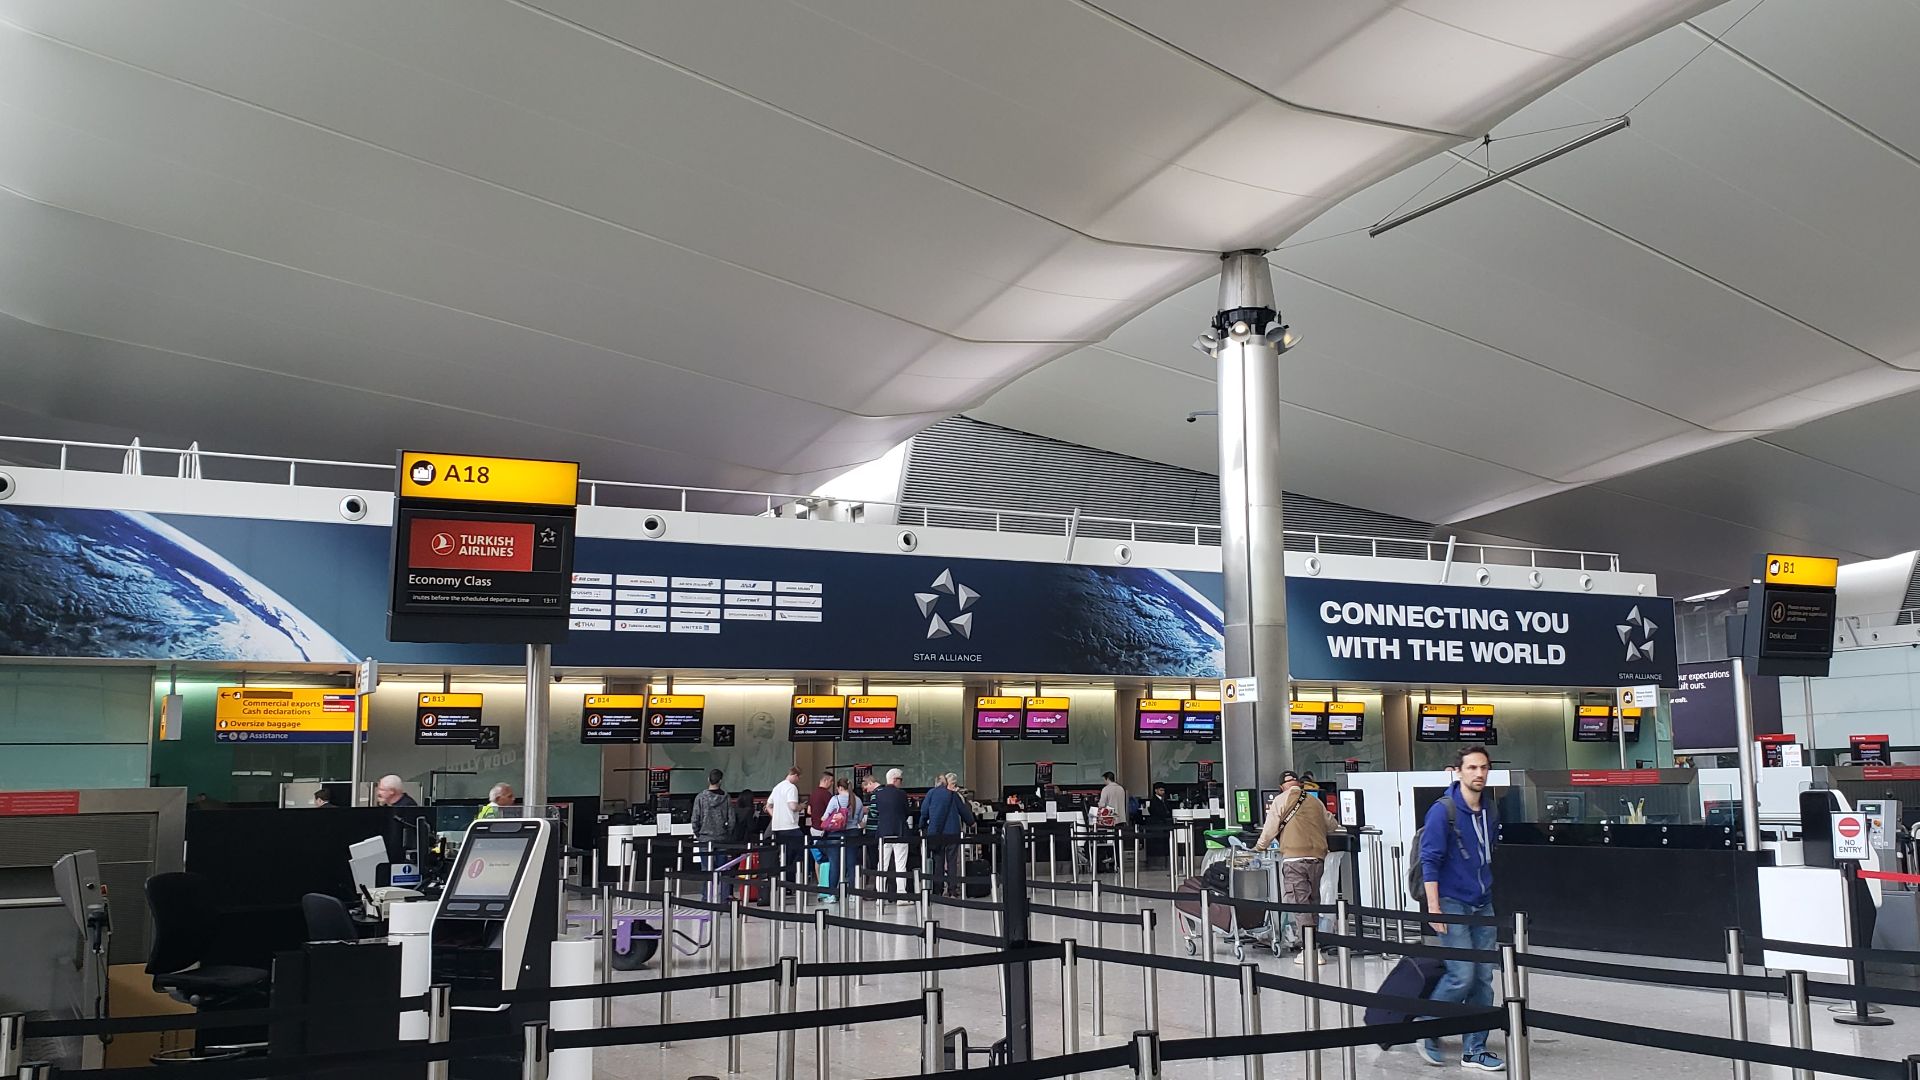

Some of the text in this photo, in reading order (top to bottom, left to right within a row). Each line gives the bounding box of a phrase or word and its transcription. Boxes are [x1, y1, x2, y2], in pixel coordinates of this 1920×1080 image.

[443, 464, 490, 484] A18
[460, 534, 514, 547] TURKISH
[458, 545, 514, 557] AIRLINES
[1783, 562, 1795, 574] B1
[408, 574, 492, 588] Economy Class
[1319, 600, 1569, 634] CONNECTING YOU
[1326, 635, 1566, 665] WITH THE WORLD
[913, 653, 982, 662] STAR ALLIANCE
[1634, 673, 1662, 681] ALLIANCE
[1688, 670, 1730, 681] expectations
[1690, 682, 1706, 690] ours.
[242, 700, 290, 708] Commercial
[291, 700, 321, 708] exports
[242, 707, 311, 716] Cash declarations
[230, 720, 301, 729] Oversize baggage
[861, 716, 891, 724] Loganair
